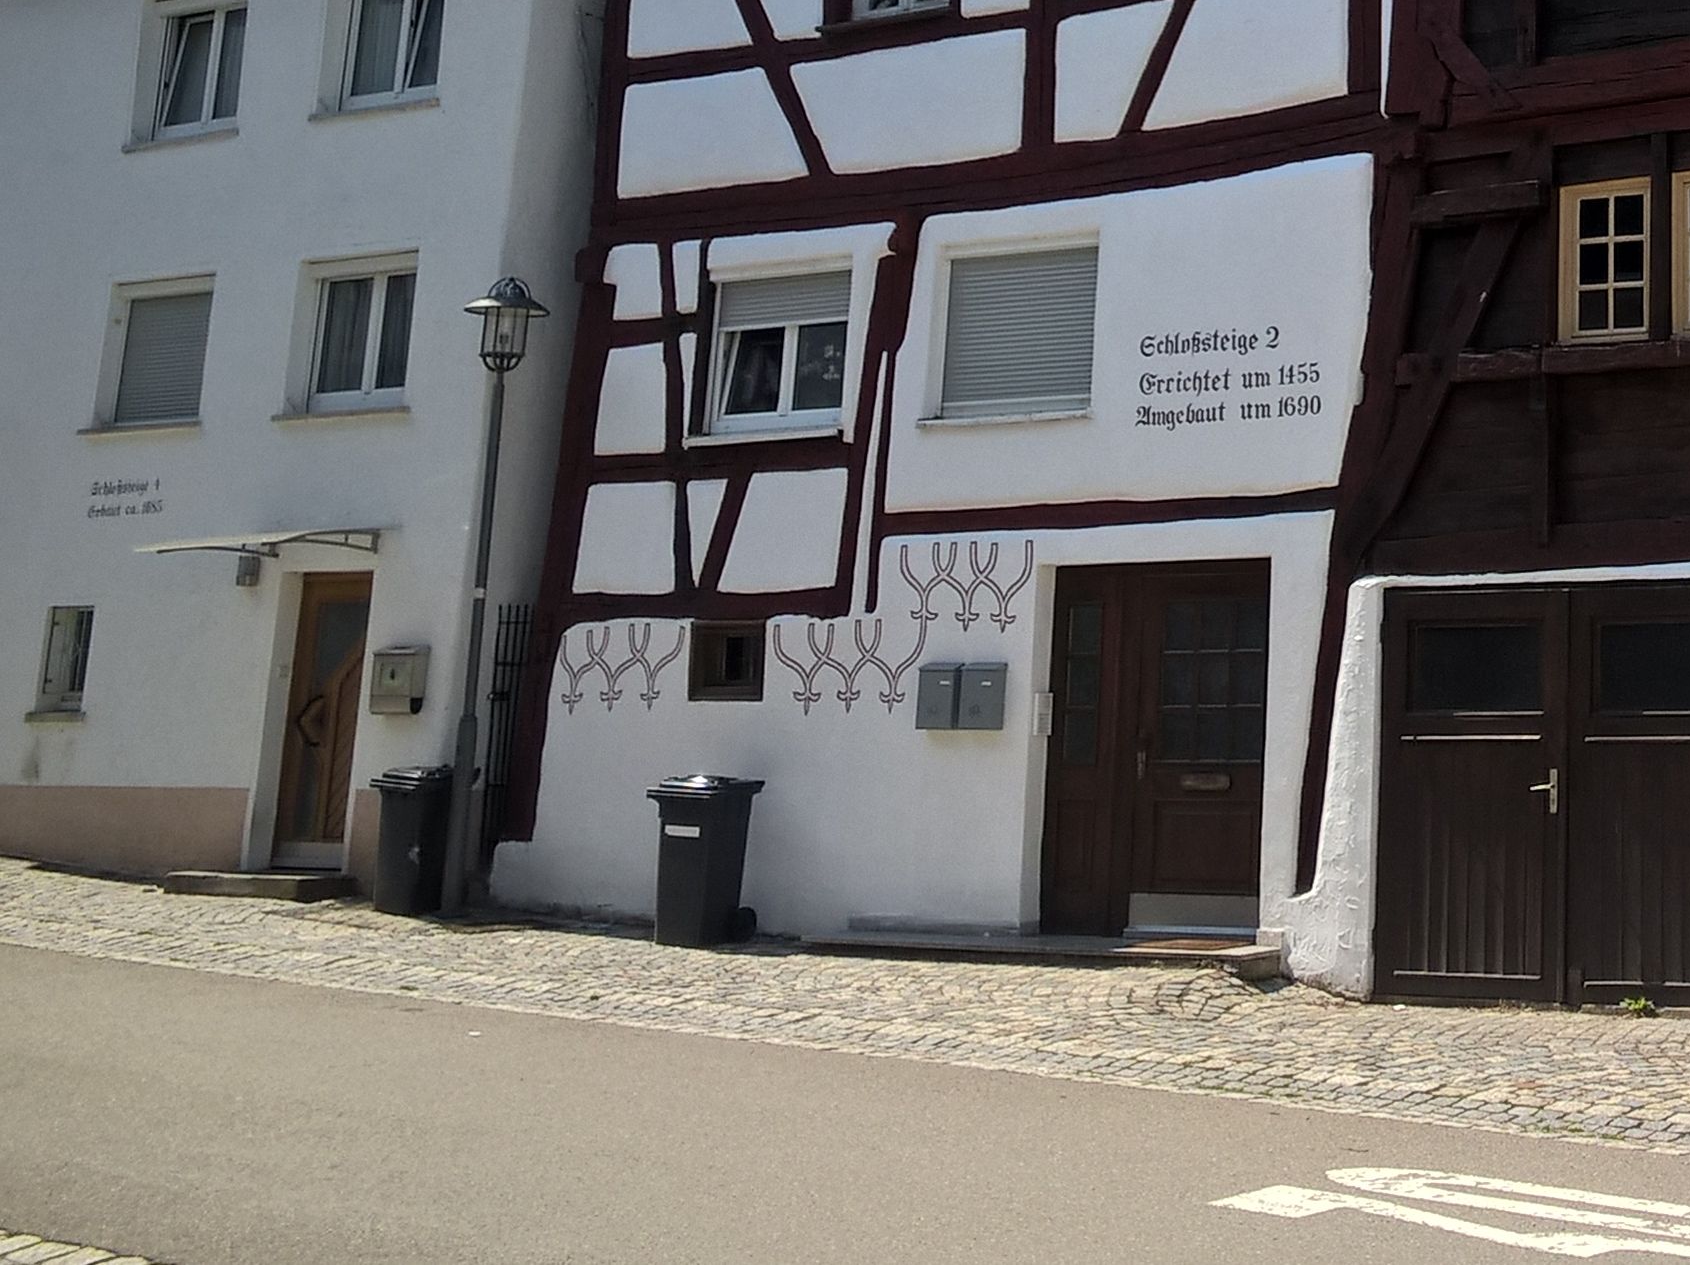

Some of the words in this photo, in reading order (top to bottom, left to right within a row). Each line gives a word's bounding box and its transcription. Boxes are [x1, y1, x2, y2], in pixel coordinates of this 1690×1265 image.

[1139, 329, 1259, 357] Schloßsteige
[1265, 325, 1280, 349] 2
[1139, 368, 1231, 396] Errichtet
[1241, 371, 1271, 390] um
[1278, 362, 1321, 386] 1455
[1240, 402, 1272, 420] um
[1277, 395, 1322, 418] 1690
